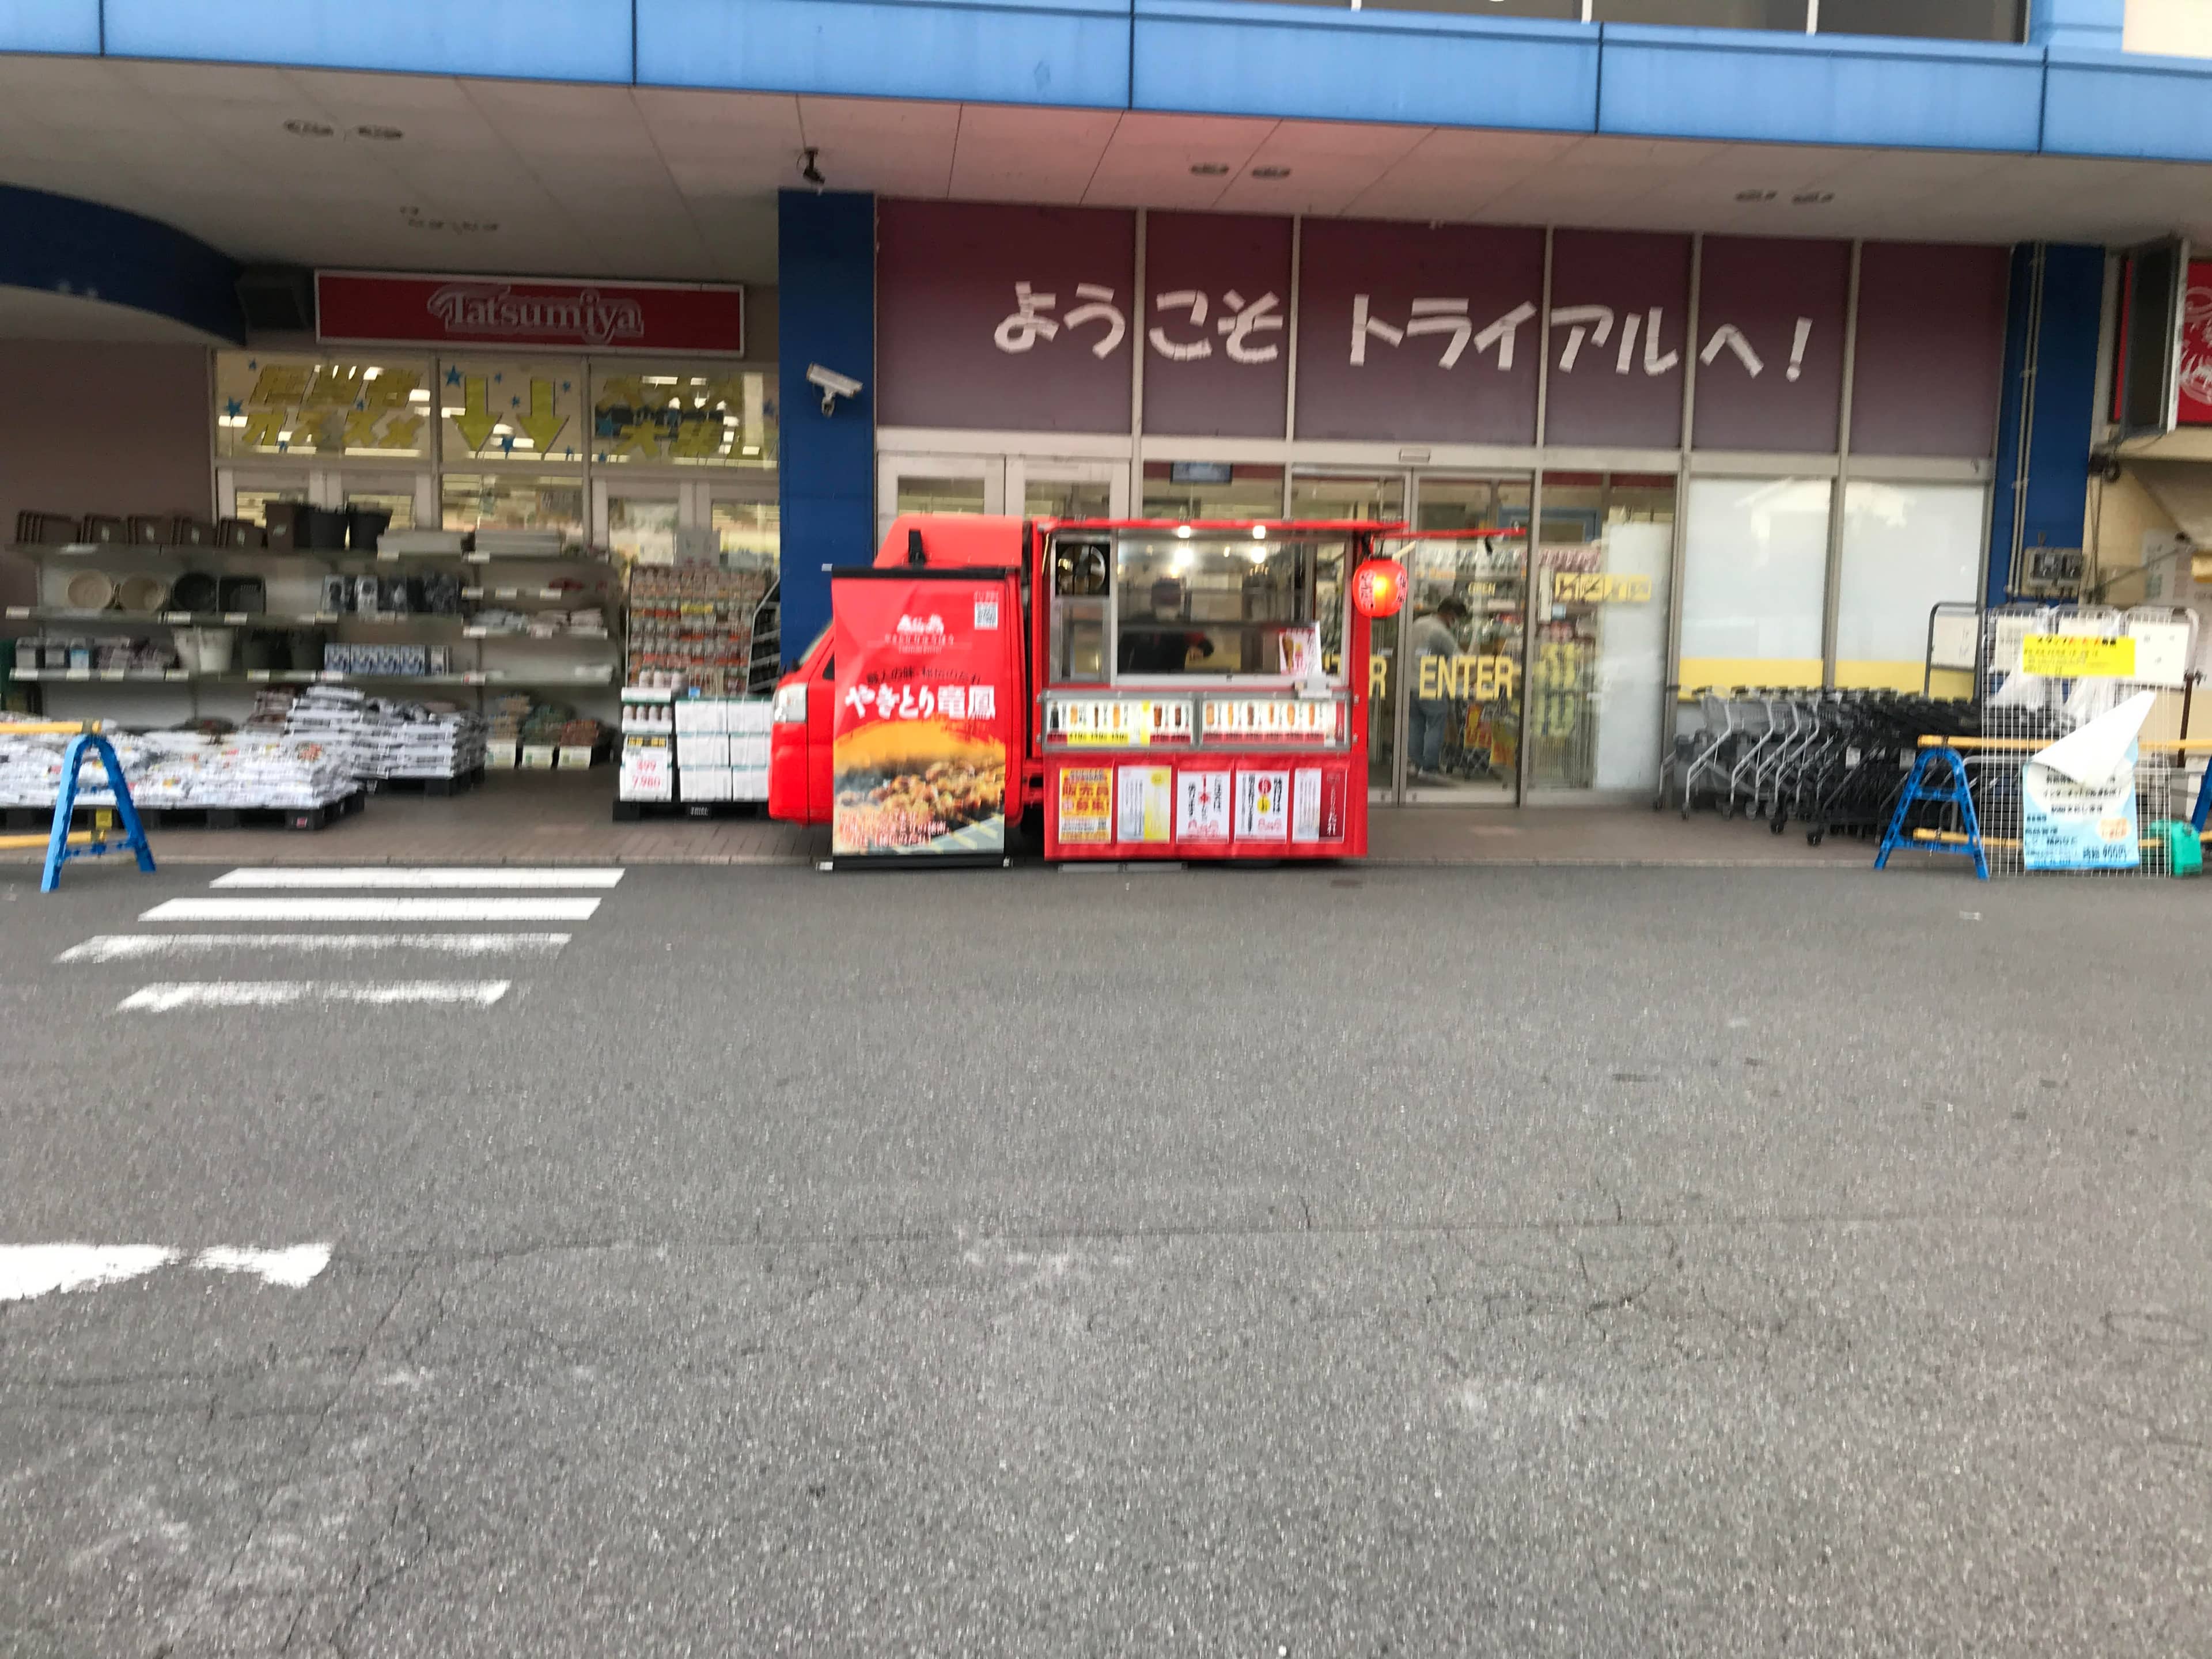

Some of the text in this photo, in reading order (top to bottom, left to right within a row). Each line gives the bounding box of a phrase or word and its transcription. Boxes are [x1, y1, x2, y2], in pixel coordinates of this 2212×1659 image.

[428, 283, 644, 345] Tatsumiya
[994, 281, 1813, 382] ようこそ トライアルへ!
[1419, 654, 1513, 700] ENTER
